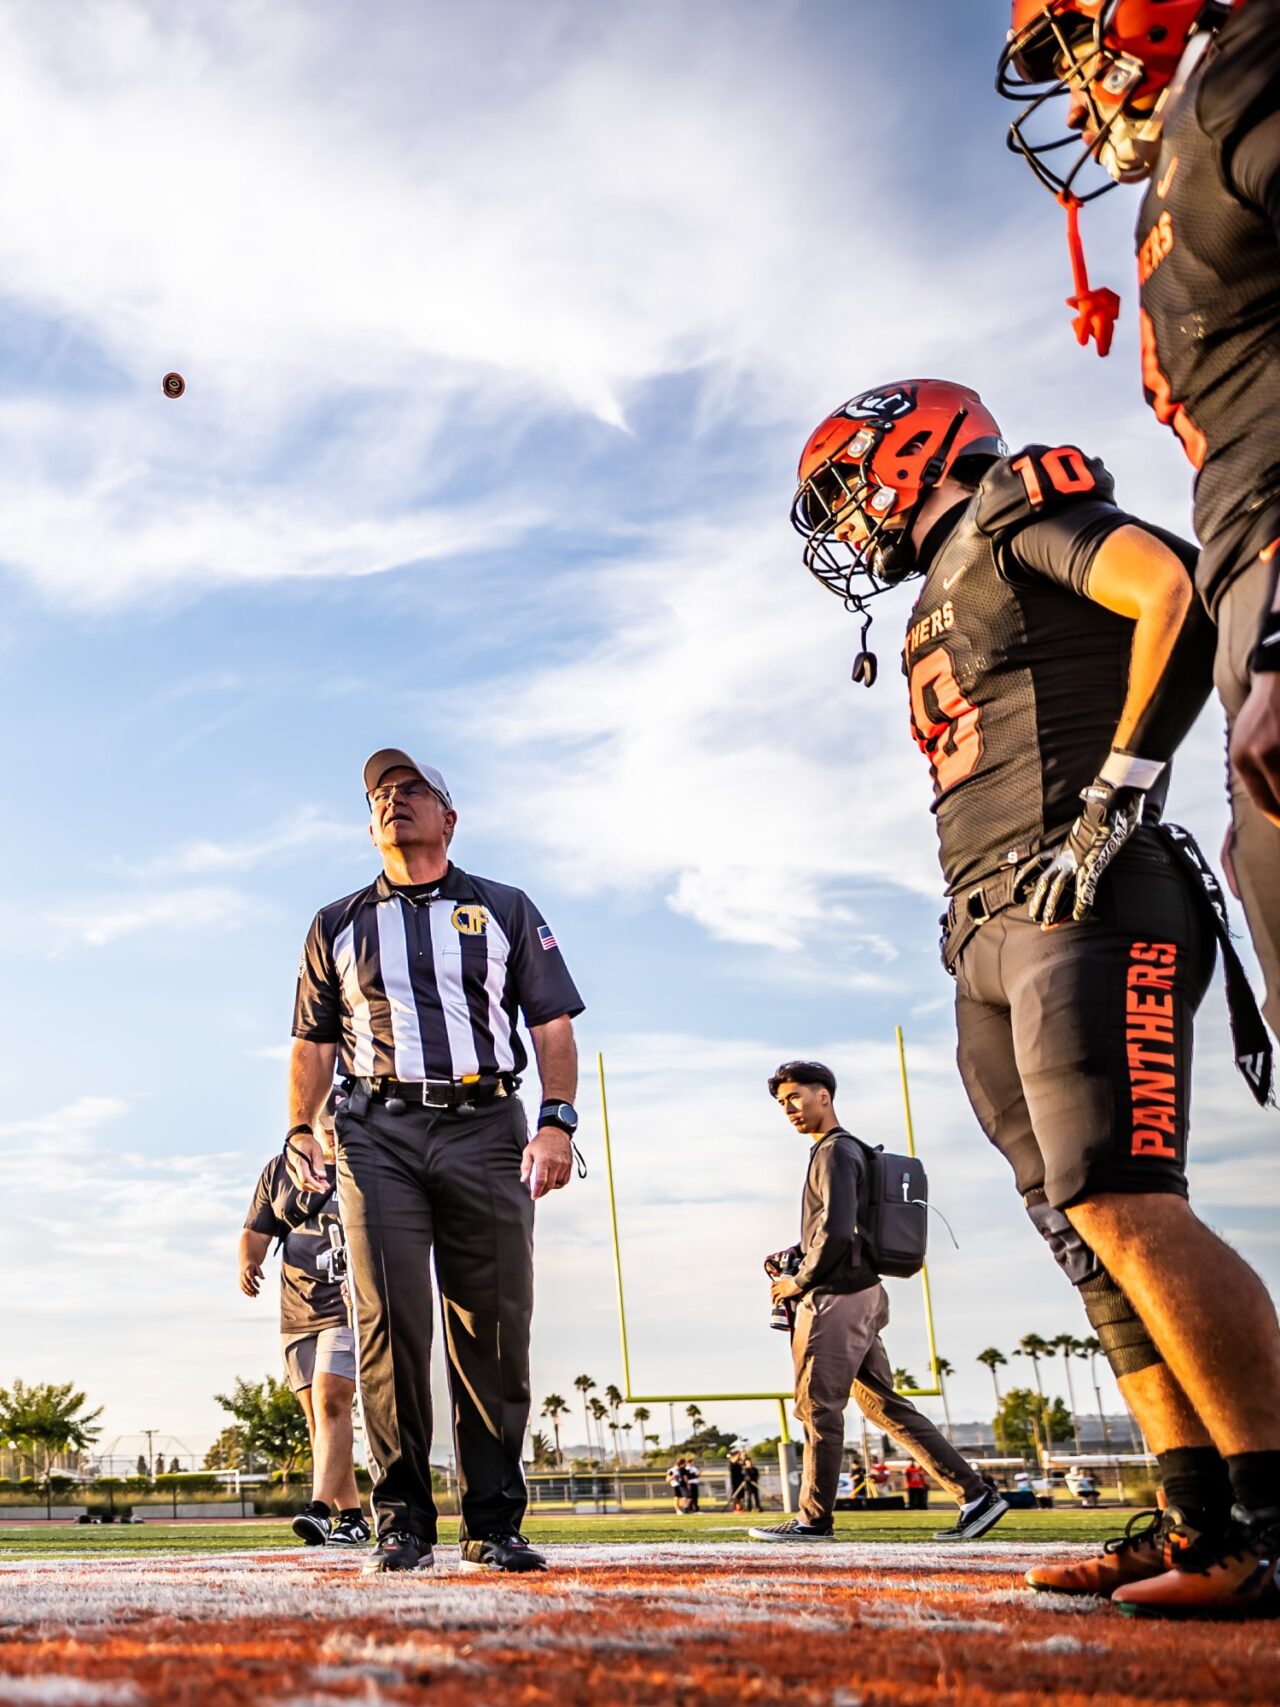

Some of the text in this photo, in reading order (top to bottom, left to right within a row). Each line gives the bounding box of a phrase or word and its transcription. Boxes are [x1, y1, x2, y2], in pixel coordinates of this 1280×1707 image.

[1012, 448, 1095, 506] 10
[451, 904, 489, 934] CIF
[1126, 942, 1177, 1158] PANTHERS
